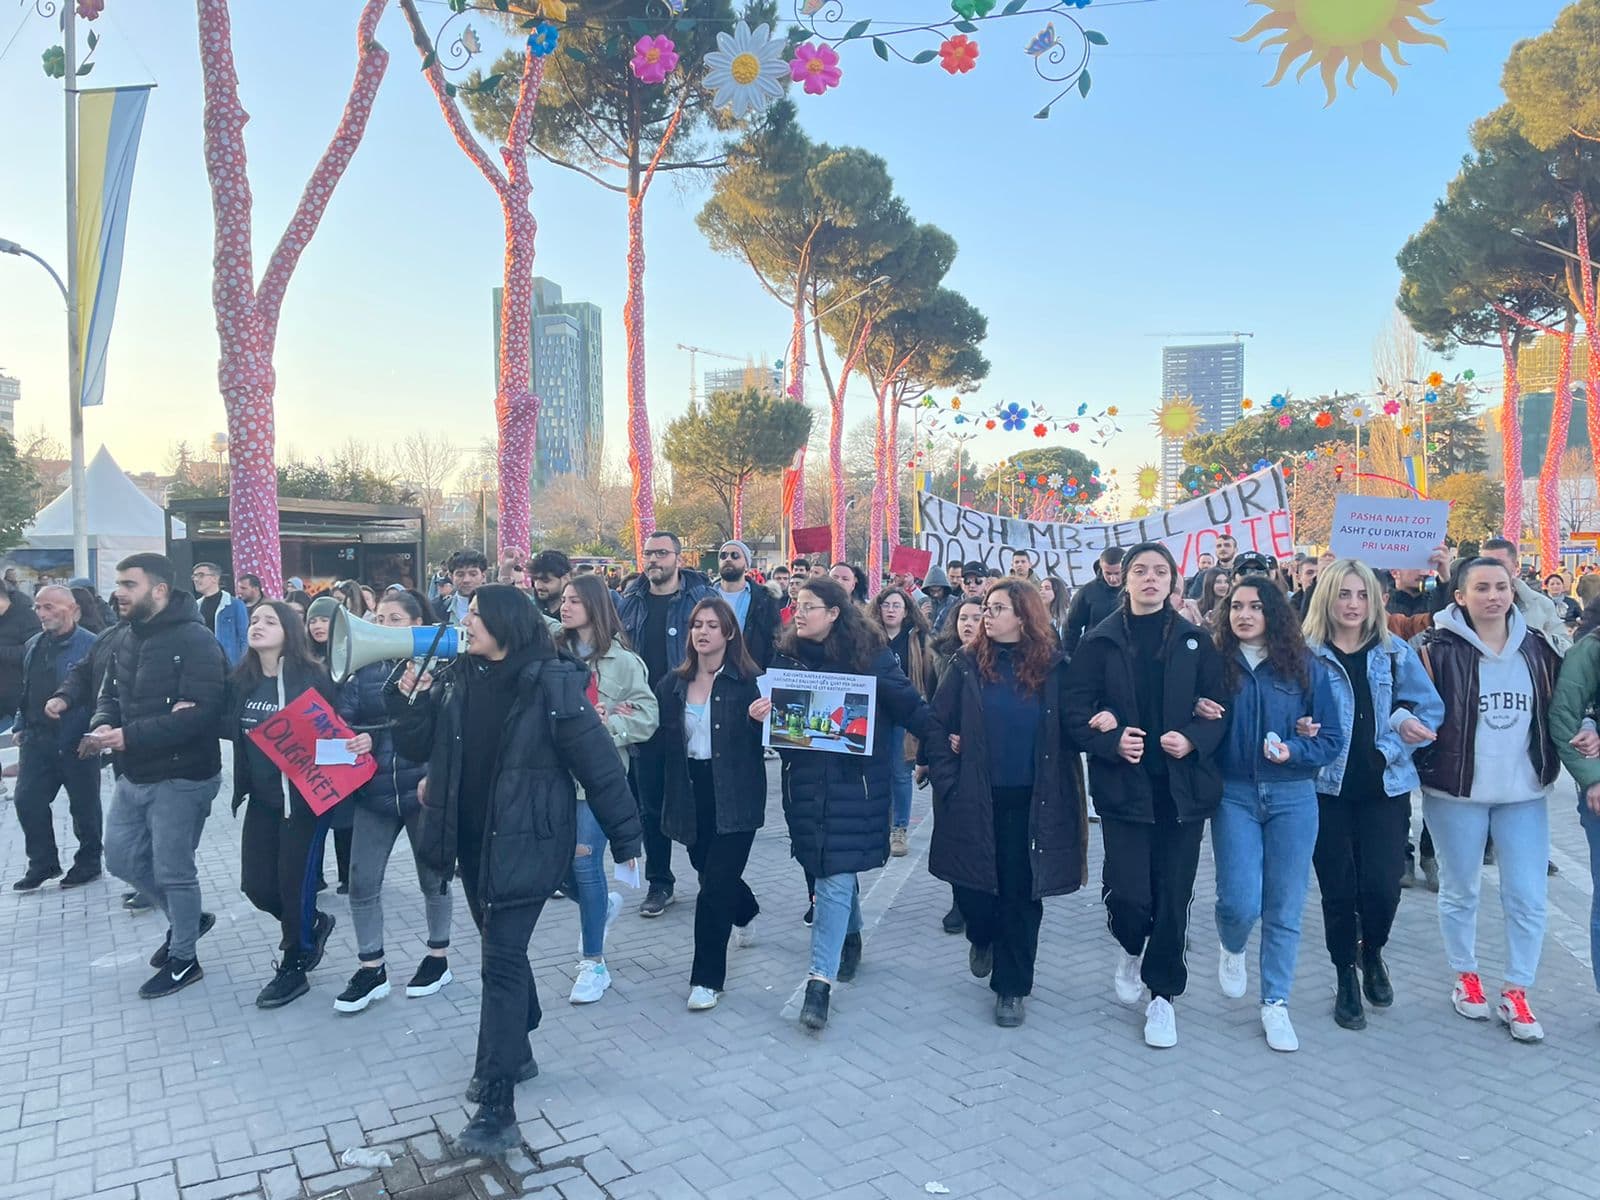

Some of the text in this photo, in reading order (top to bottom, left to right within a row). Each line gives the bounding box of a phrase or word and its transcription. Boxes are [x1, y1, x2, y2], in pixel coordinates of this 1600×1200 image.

[918, 467, 1286, 550] KUSH MBJELL URI
[1350, 512, 1383, 521] PASHA
[1411, 516, 1431, 525] ZOT
[1159, 509, 1294, 577] VOTË
[1340, 525, 1437, 540] ASHT ÇU DIKTATORI
[1361, 541, 1410, 552] PRI VARRI
[1479, 692, 1532, 713] STBH
[263, 717, 341, 802] OLIGARKËT
